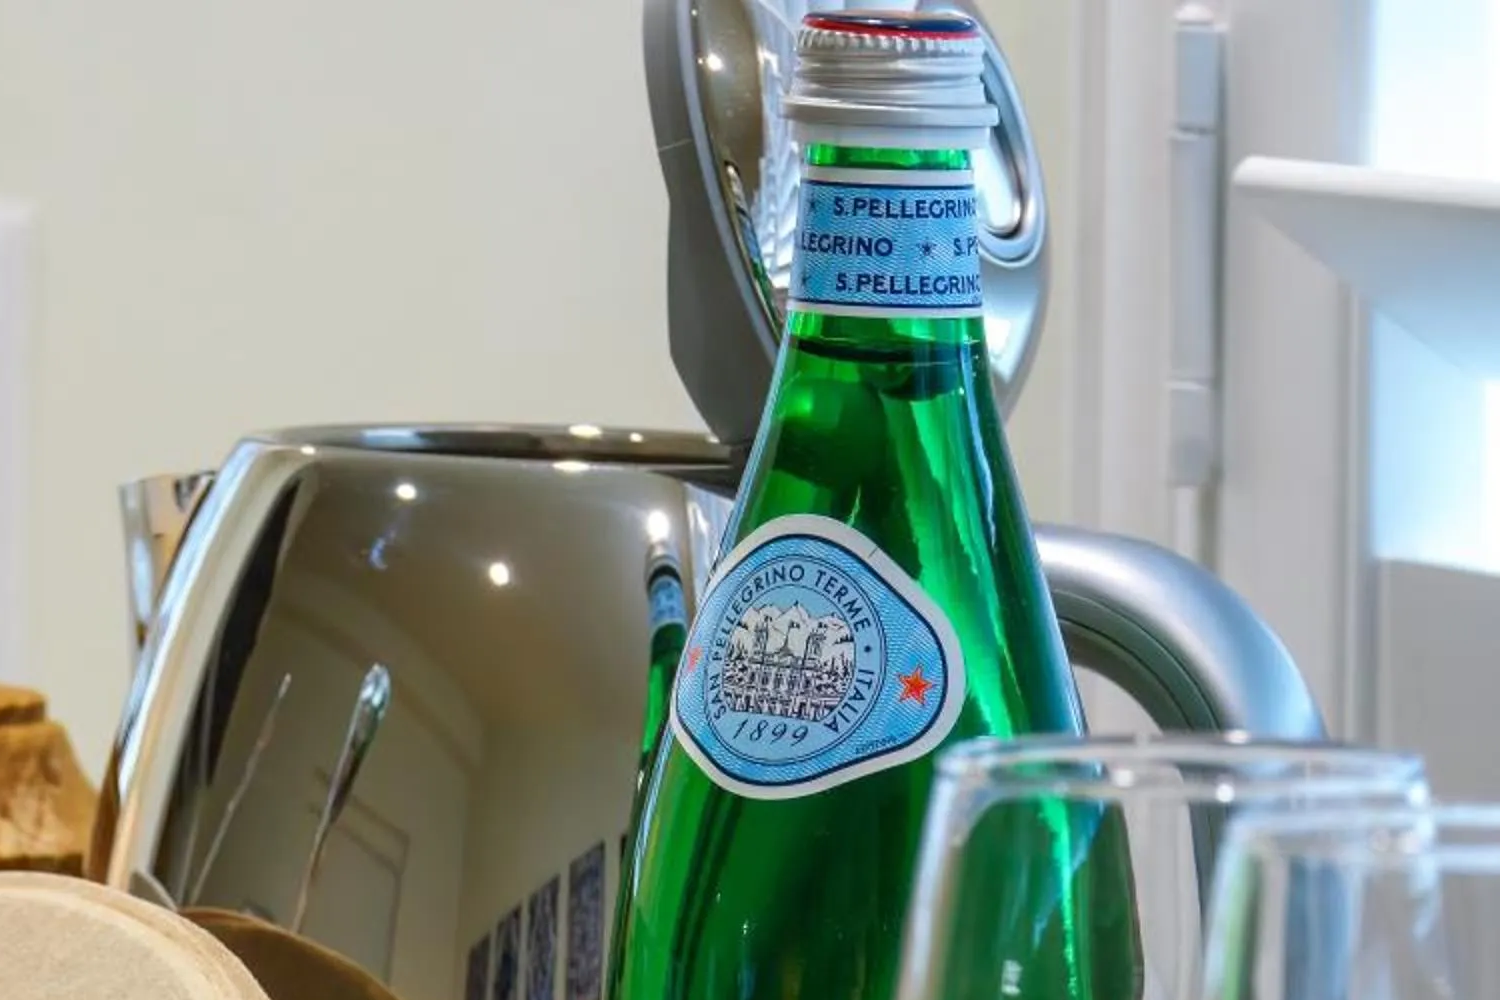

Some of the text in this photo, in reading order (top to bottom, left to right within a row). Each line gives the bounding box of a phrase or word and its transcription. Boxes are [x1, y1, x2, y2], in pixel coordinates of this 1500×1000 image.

[834, 197, 977, 219] S.PELLEGRIN
[711, 563, 806, 662] PELLEGRINO
[813, 568, 871, 633] TERME
[823, 667, 875, 733] ITALIA
[732, 718, 809, 748] 1899
